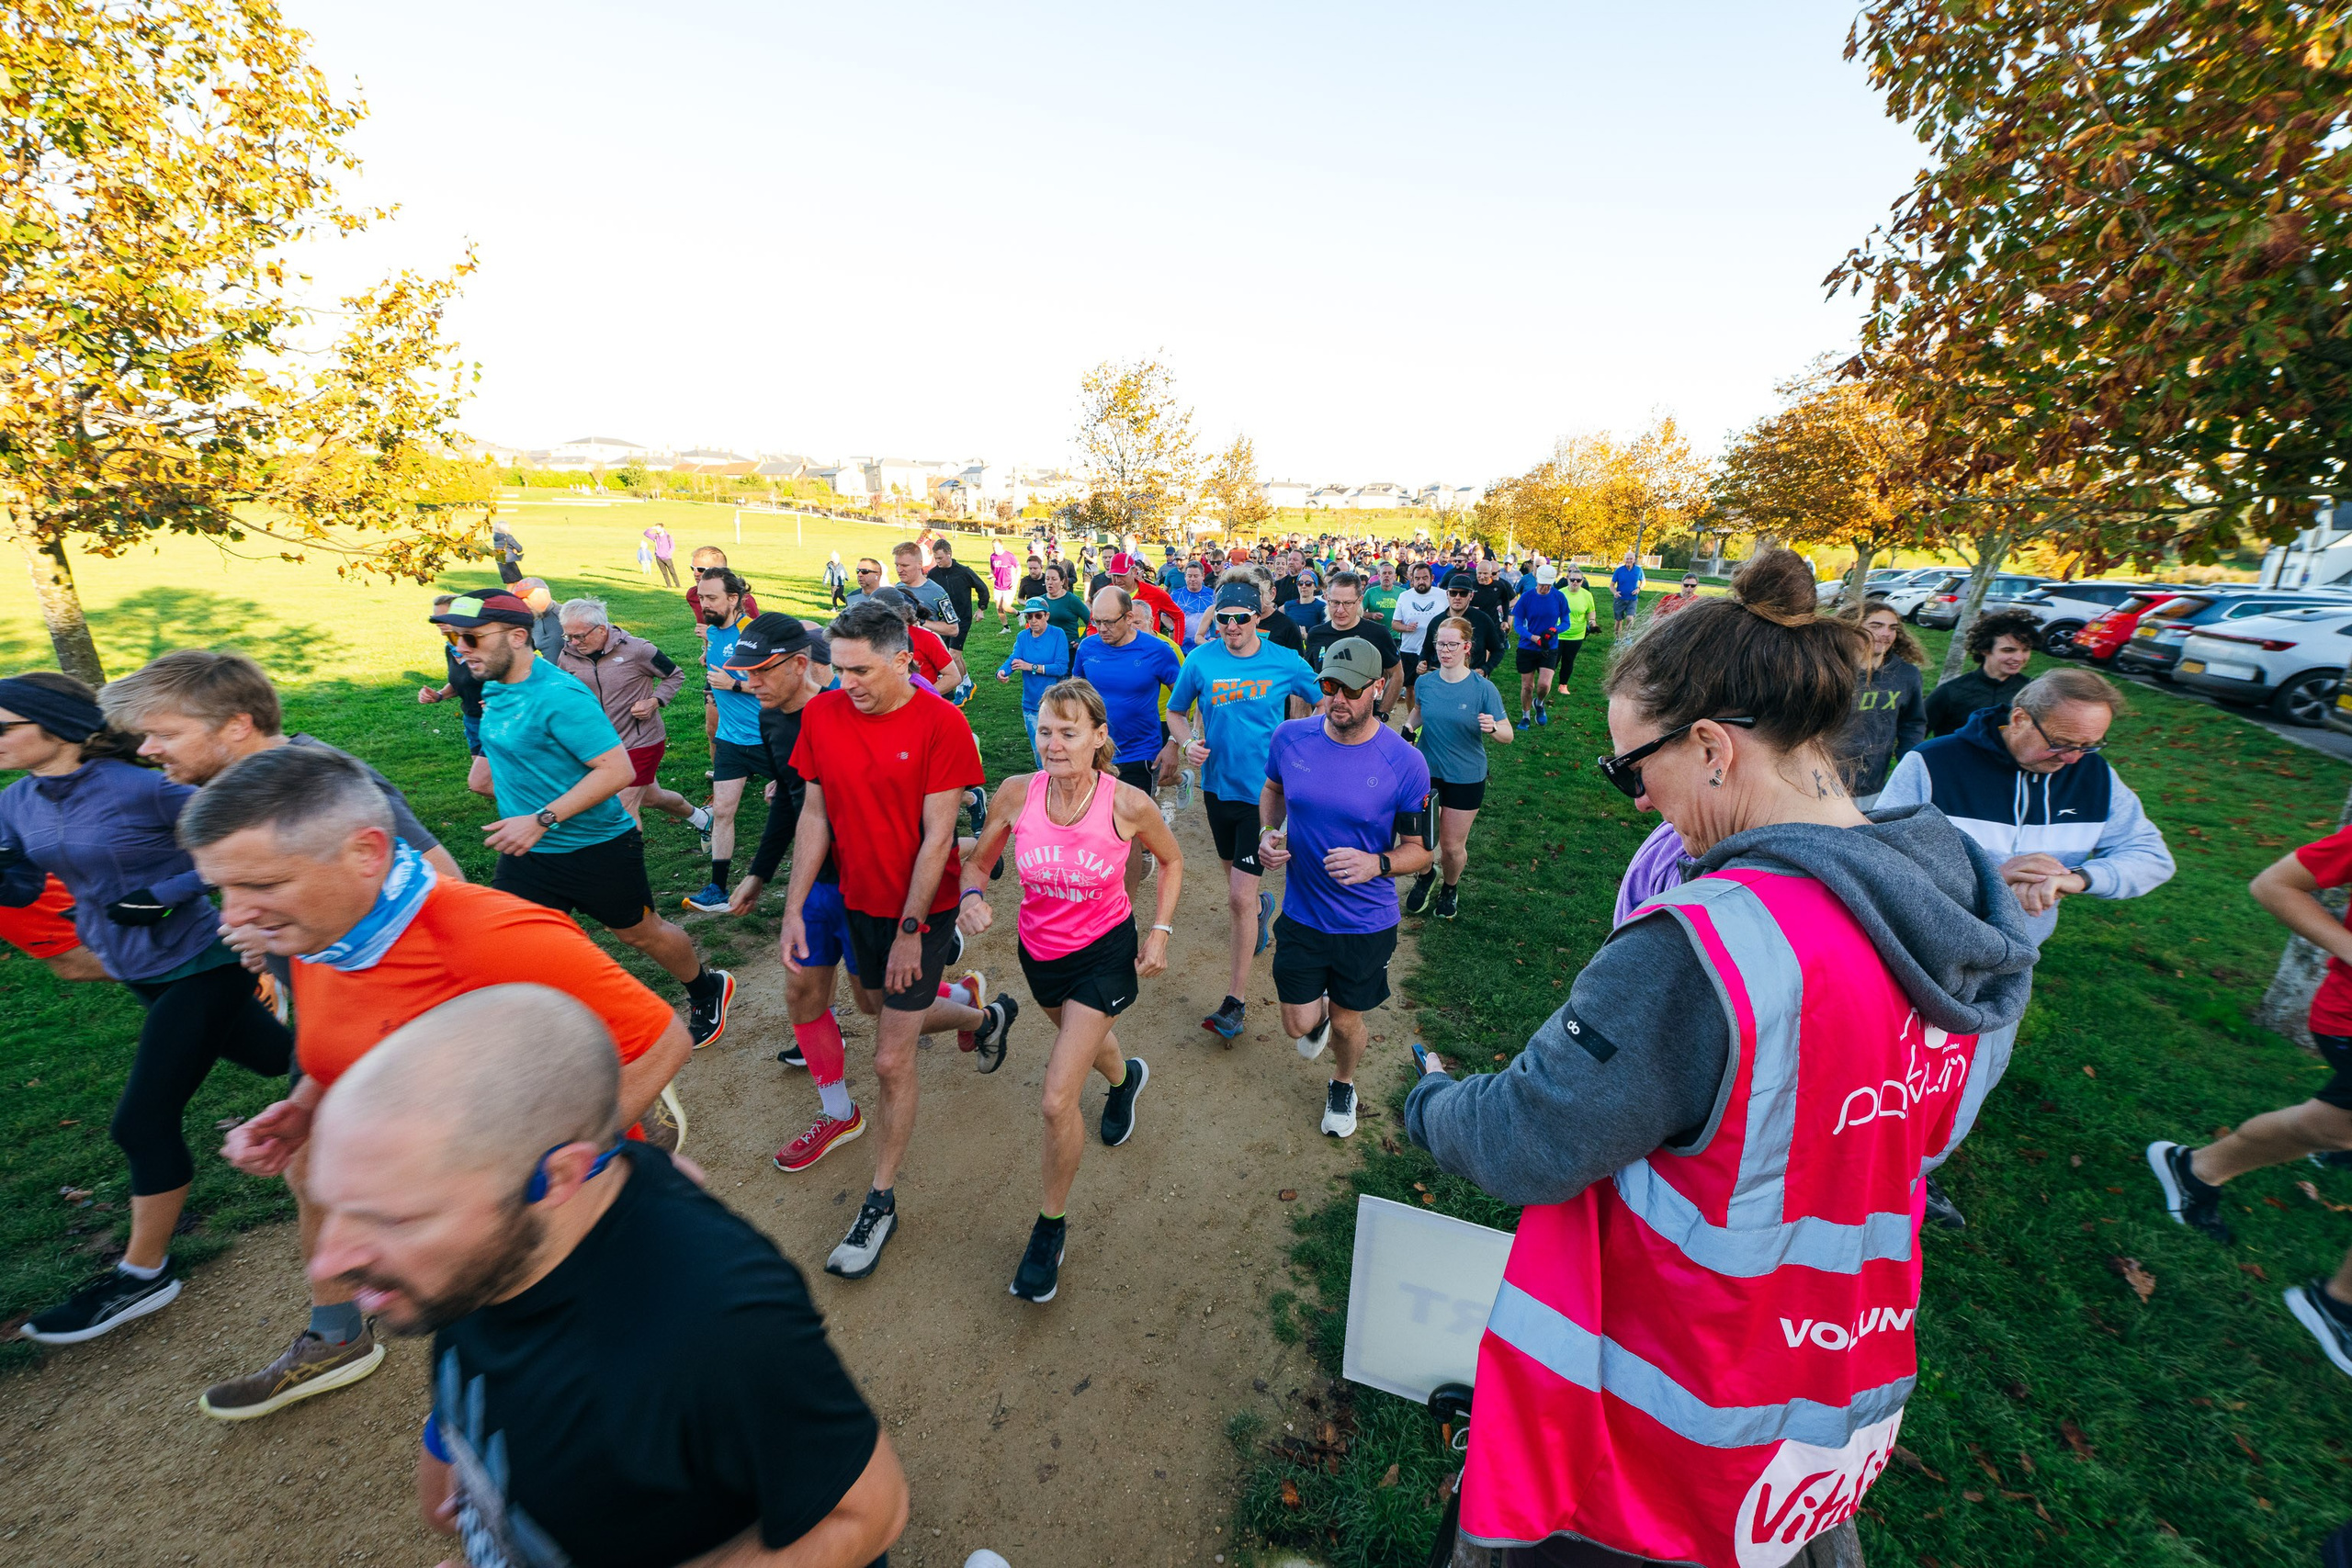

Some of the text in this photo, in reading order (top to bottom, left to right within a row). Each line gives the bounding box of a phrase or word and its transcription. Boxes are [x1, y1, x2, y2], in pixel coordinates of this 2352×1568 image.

[1212, 680, 1272, 705] RIOT
[1016, 845, 1115, 882] WHITE STAR
